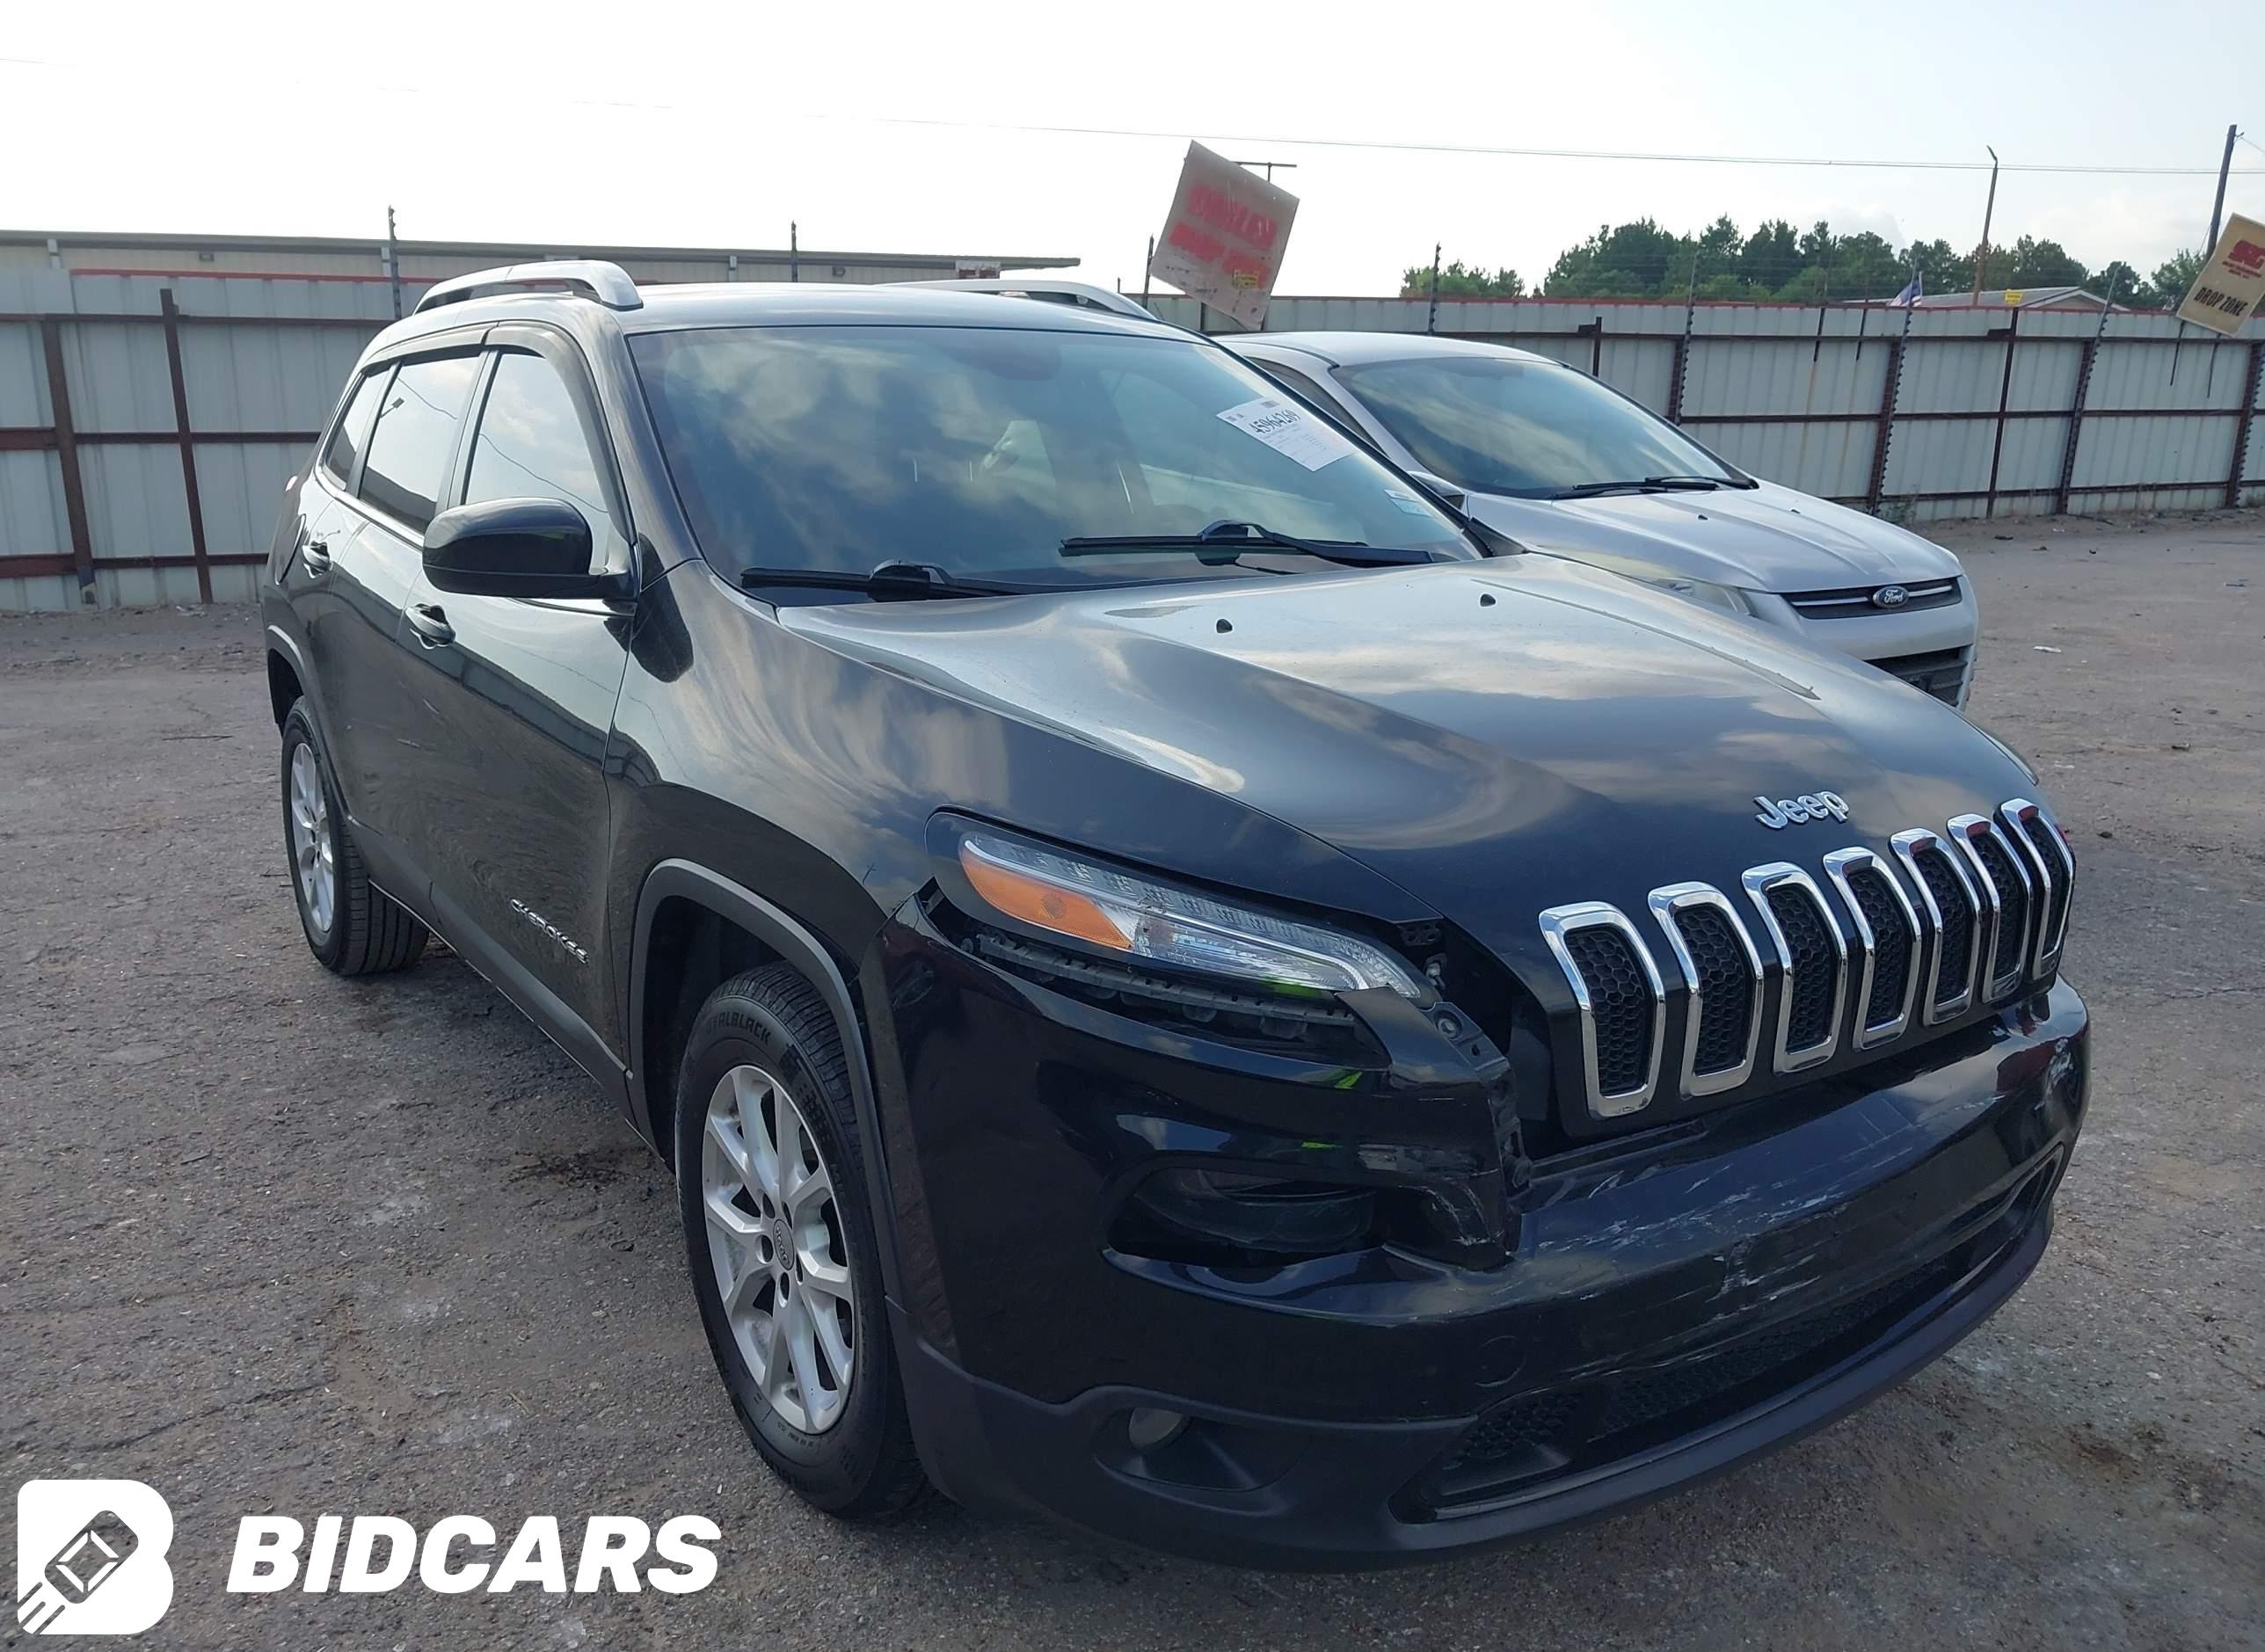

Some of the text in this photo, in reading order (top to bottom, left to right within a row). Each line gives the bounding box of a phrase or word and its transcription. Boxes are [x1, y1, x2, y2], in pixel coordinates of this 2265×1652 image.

[2194, 287, 2248, 317] DROP ZONE
[1884, 589, 1904, 603] Ford
[1752, 790, 1849, 829] Jeep
